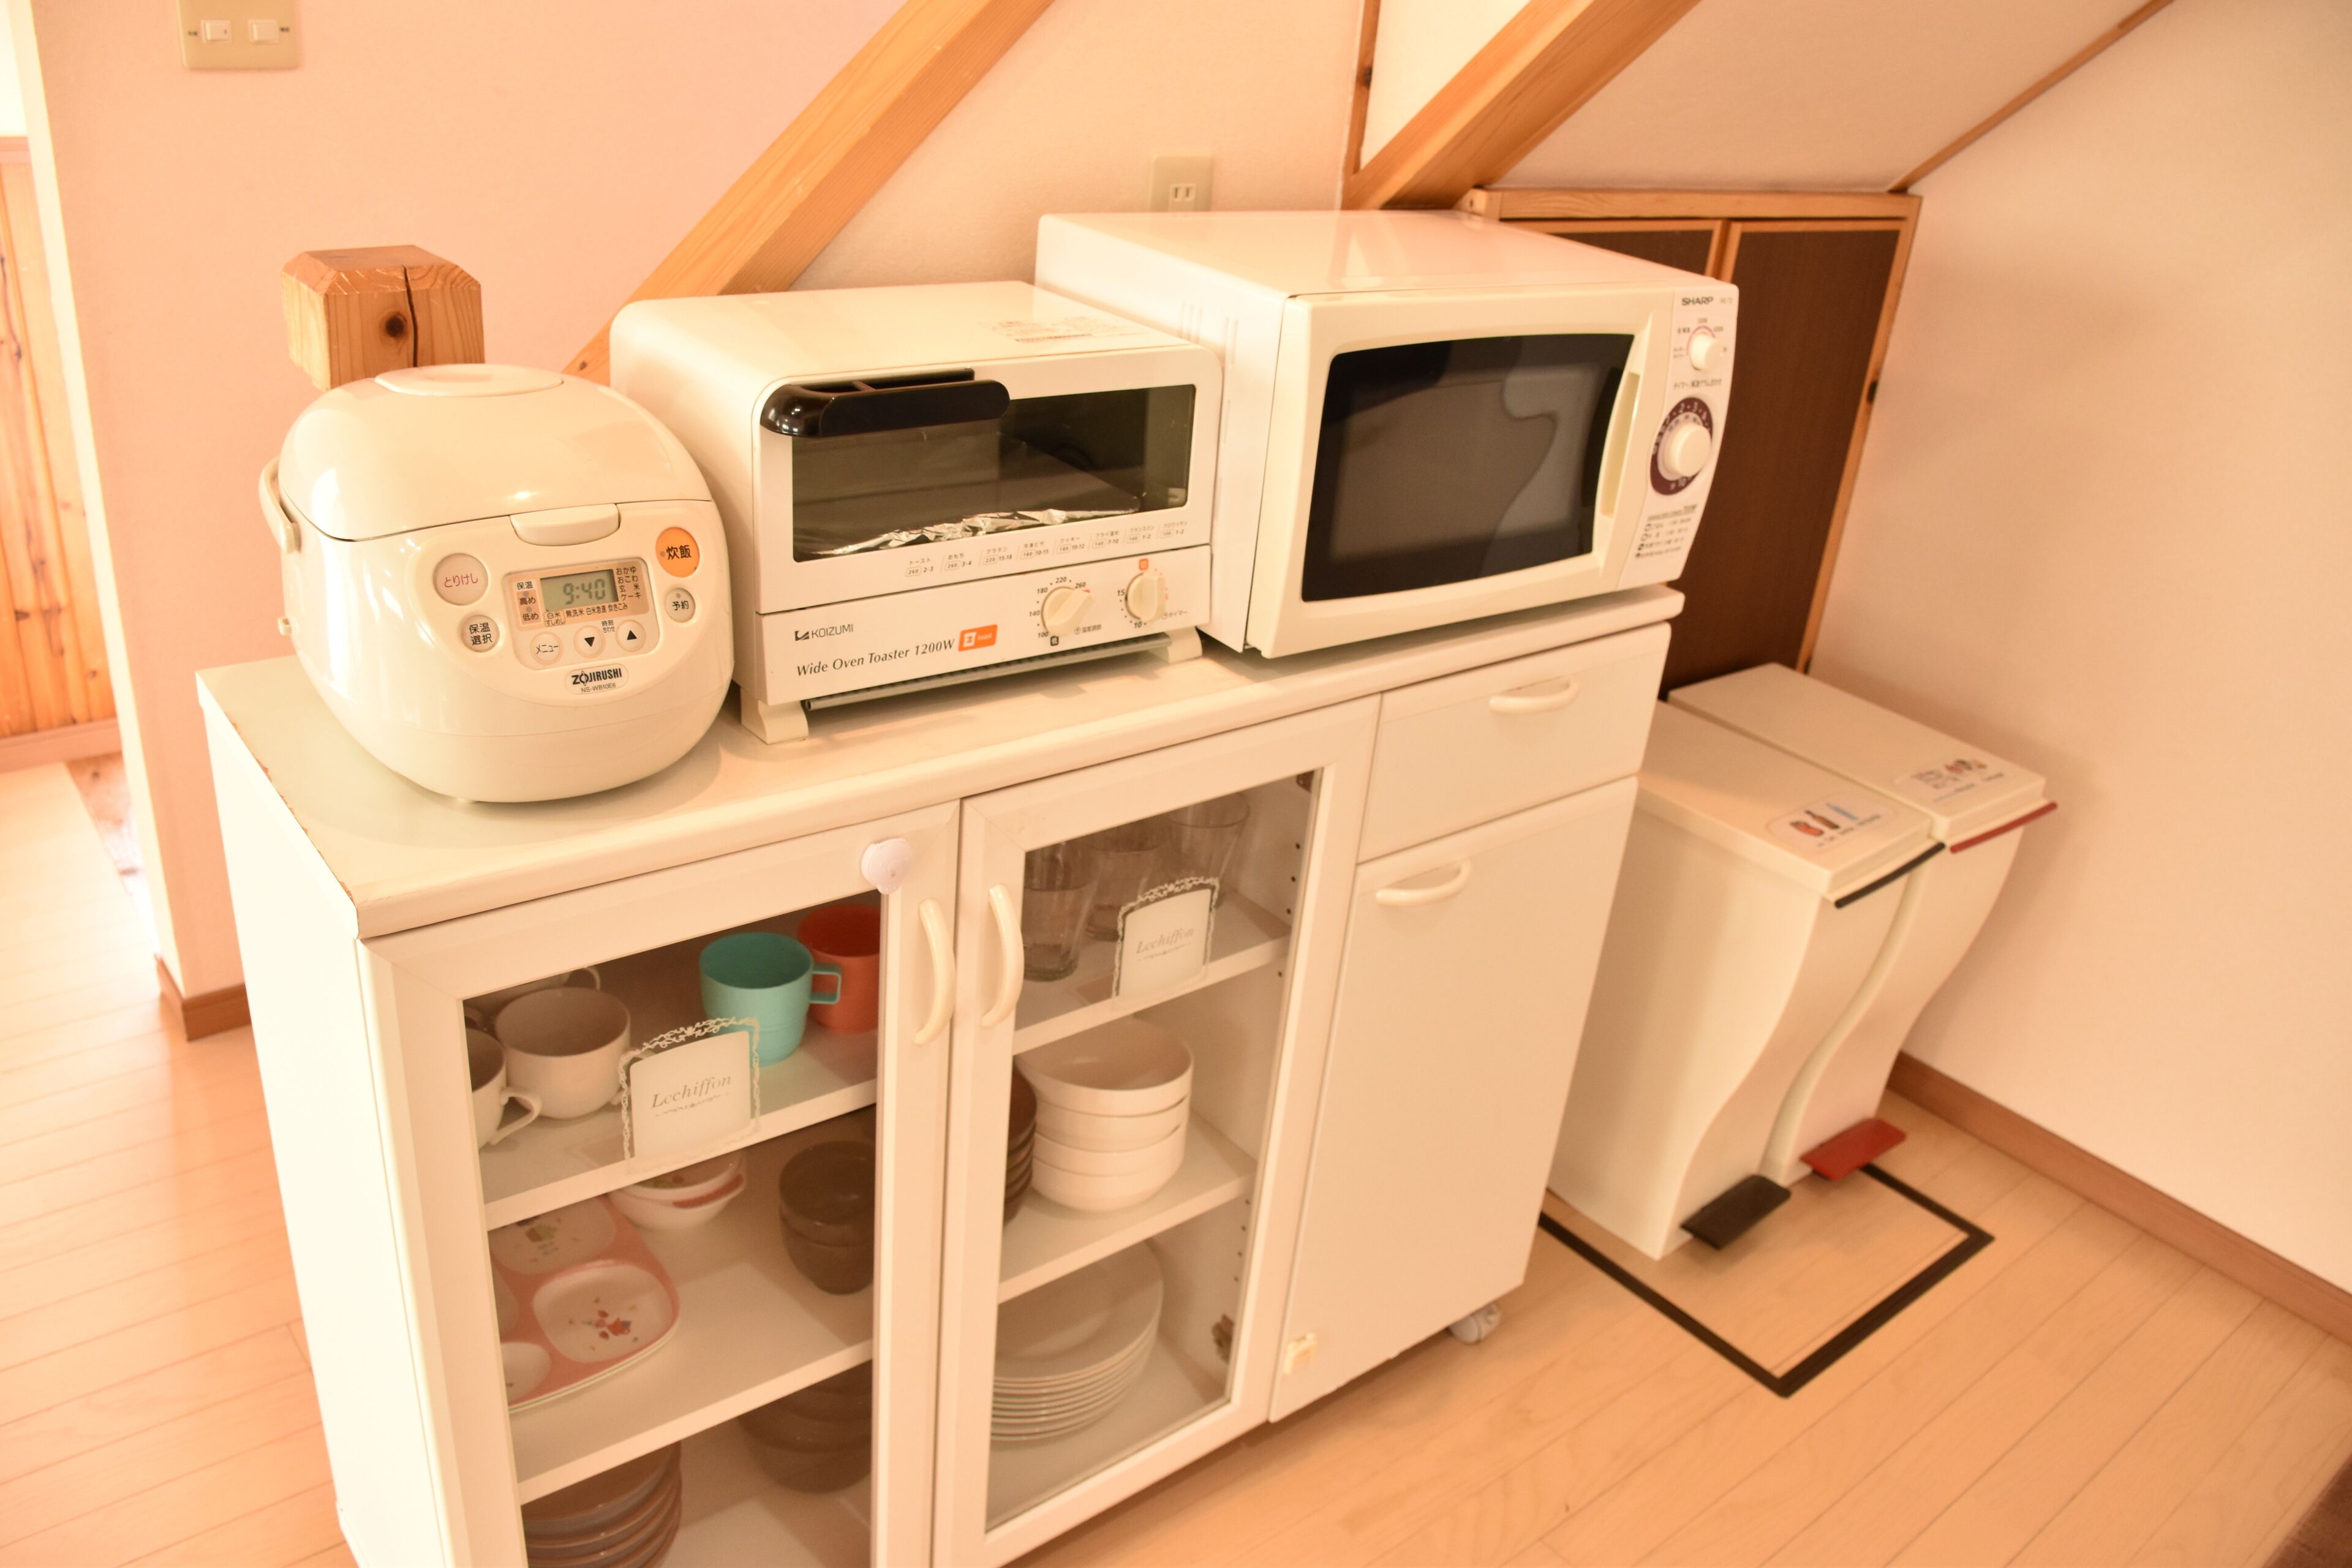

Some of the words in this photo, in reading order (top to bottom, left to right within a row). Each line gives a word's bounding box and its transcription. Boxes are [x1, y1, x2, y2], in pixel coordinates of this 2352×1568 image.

[1682, 296, 1713, 306] SHARP
[666, 545, 692, 560] 炊飯
[616, 567, 637, 576] おかゆ
[444, 573, 478, 587] とりけし
[617, 575, 638, 584] おこわ
[517, 581, 533, 590] 保温
[563, 578, 606, 605] 9:40
[620, 592, 641, 601] ケーキ
[519, 597, 536, 605] 高め
[672, 600, 689, 611] 予約
[608, 602, 628, 612] 炊きこみ
[522, 612, 539, 622] 低め
[566, 609, 585, 618] 無洗米
[546, 617, 565, 626] すしめし
[469, 622, 491, 635] 保温
[811, 624, 854, 638] KOIZUMI
[470, 633, 492, 646] 選択
[536, 644, 559, 654] メニュー
[797, 663, 828, 676] Wide
[832, 657, 864, 670] Oven
[869, 649, 910, 664] Toaster
[915, 639, 956, 655] 1200W
[571, 668, 622, 685] ZOJIRUSHI
[581, 682, 616, 693] NS-WB10E6
[652, 1076, 731, 1108] Lechiffon
